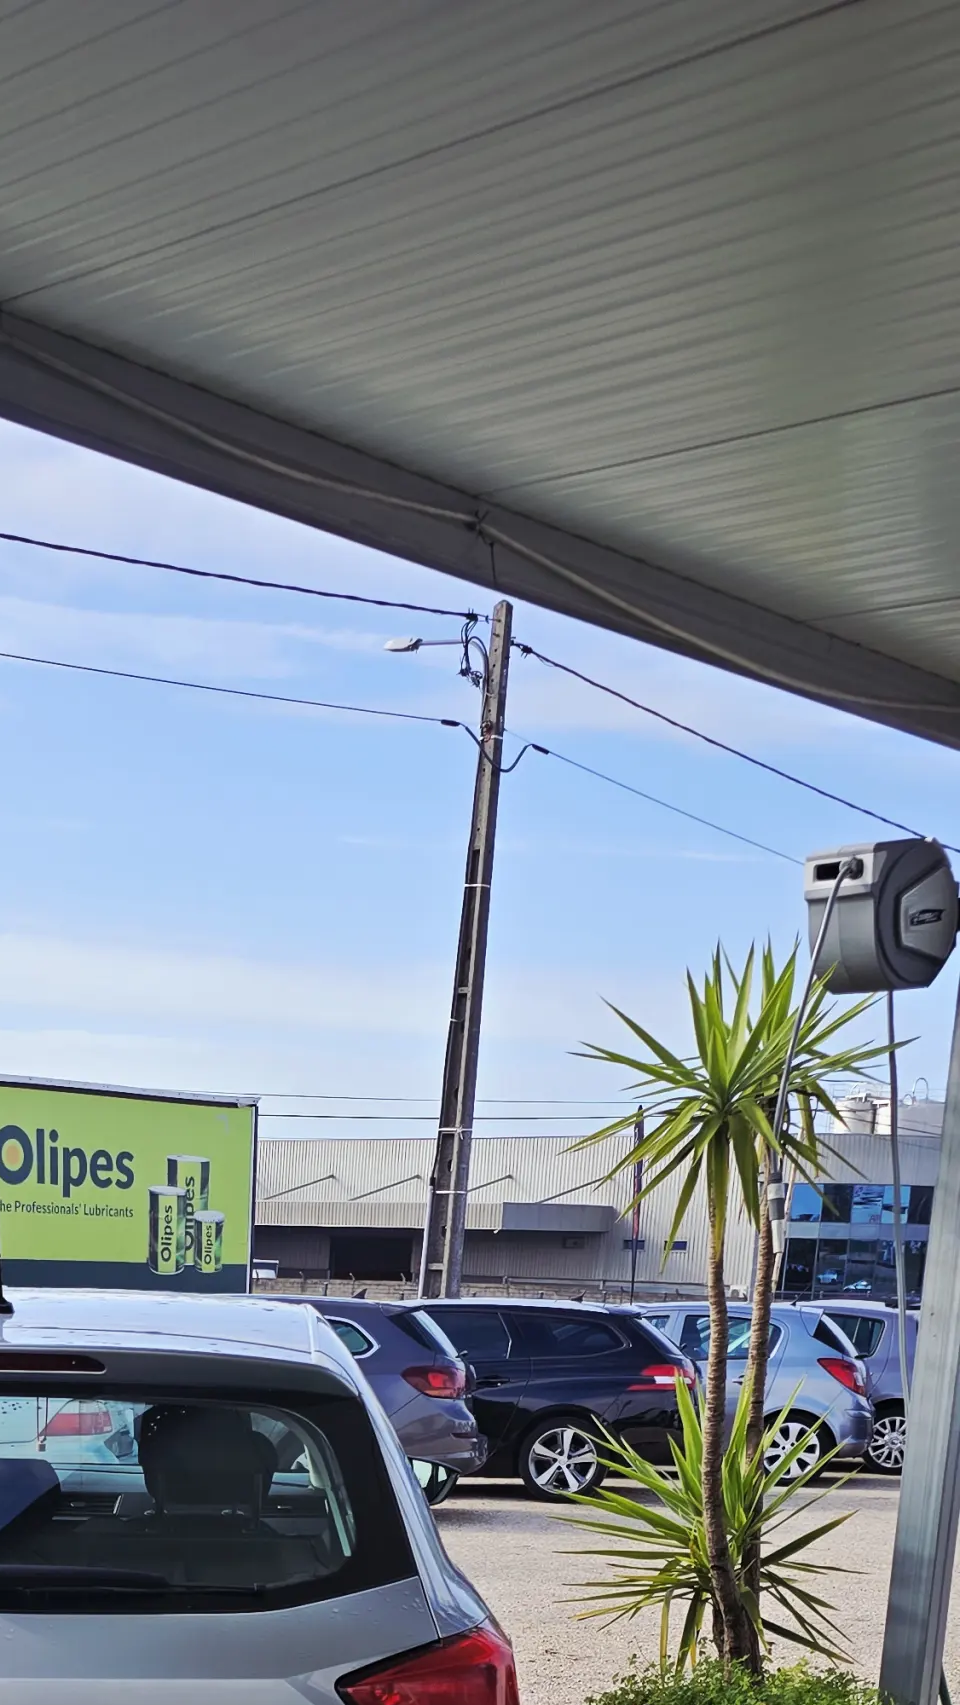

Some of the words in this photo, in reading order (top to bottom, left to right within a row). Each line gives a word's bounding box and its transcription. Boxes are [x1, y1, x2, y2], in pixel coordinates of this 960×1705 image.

[14, 1200, 82, 1216] Professionals'
[83, 1203, 134, 1218] Lubricants
[160, 1204, 174, 1262] Olipes
[204, 1225, 214, 1265] Olipes
